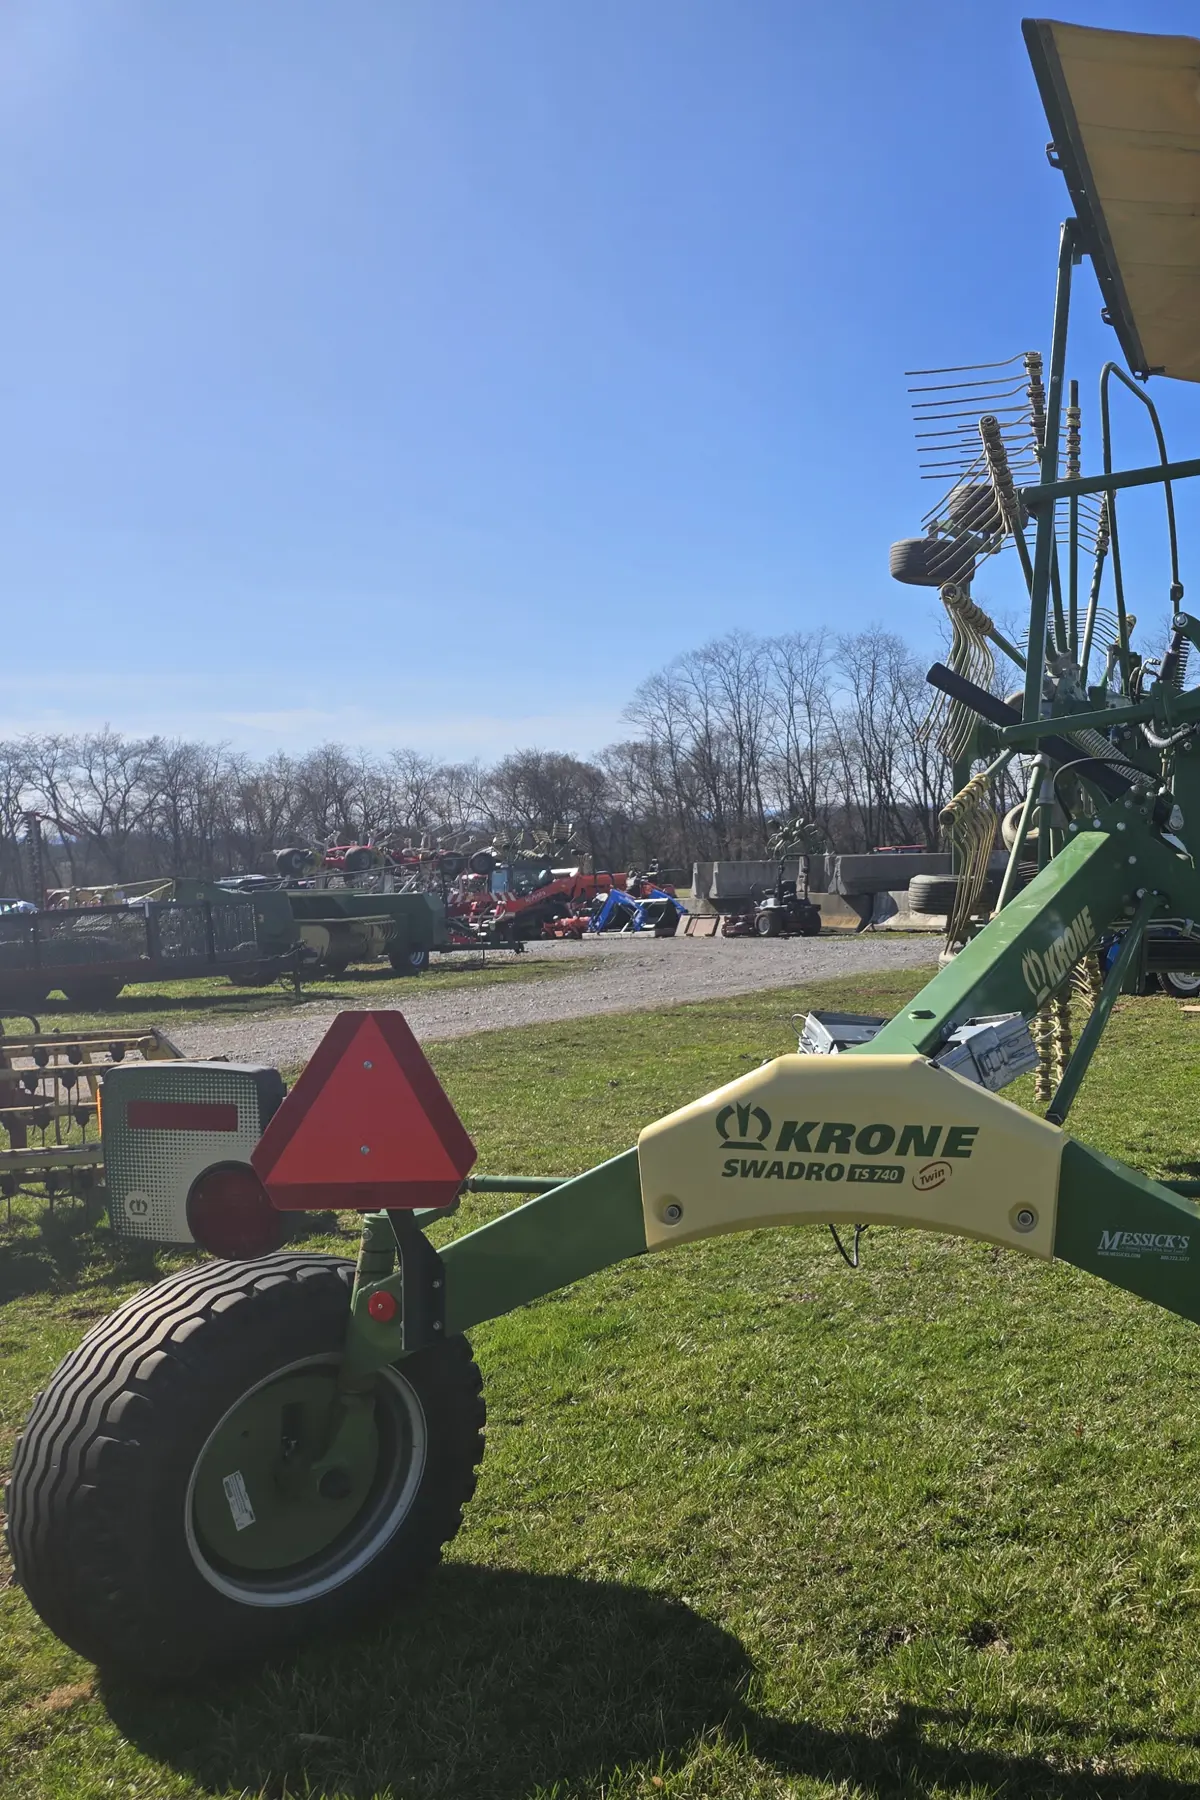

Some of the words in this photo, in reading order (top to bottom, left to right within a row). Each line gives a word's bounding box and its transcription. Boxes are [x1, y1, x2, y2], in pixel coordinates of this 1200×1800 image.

[1043, 905, 1096, 987] KRONE
[775, 1121, 980, 1158] KRONE
[721, 1159, 845, 1182] SWADRO
[854, 1168, 870, 1180] TS
[873, 1169, 899, 1181] 740
[920, 1168, 945, 1185] Twin
[1098, 1230, 1190, 1250] MESSICK'S
